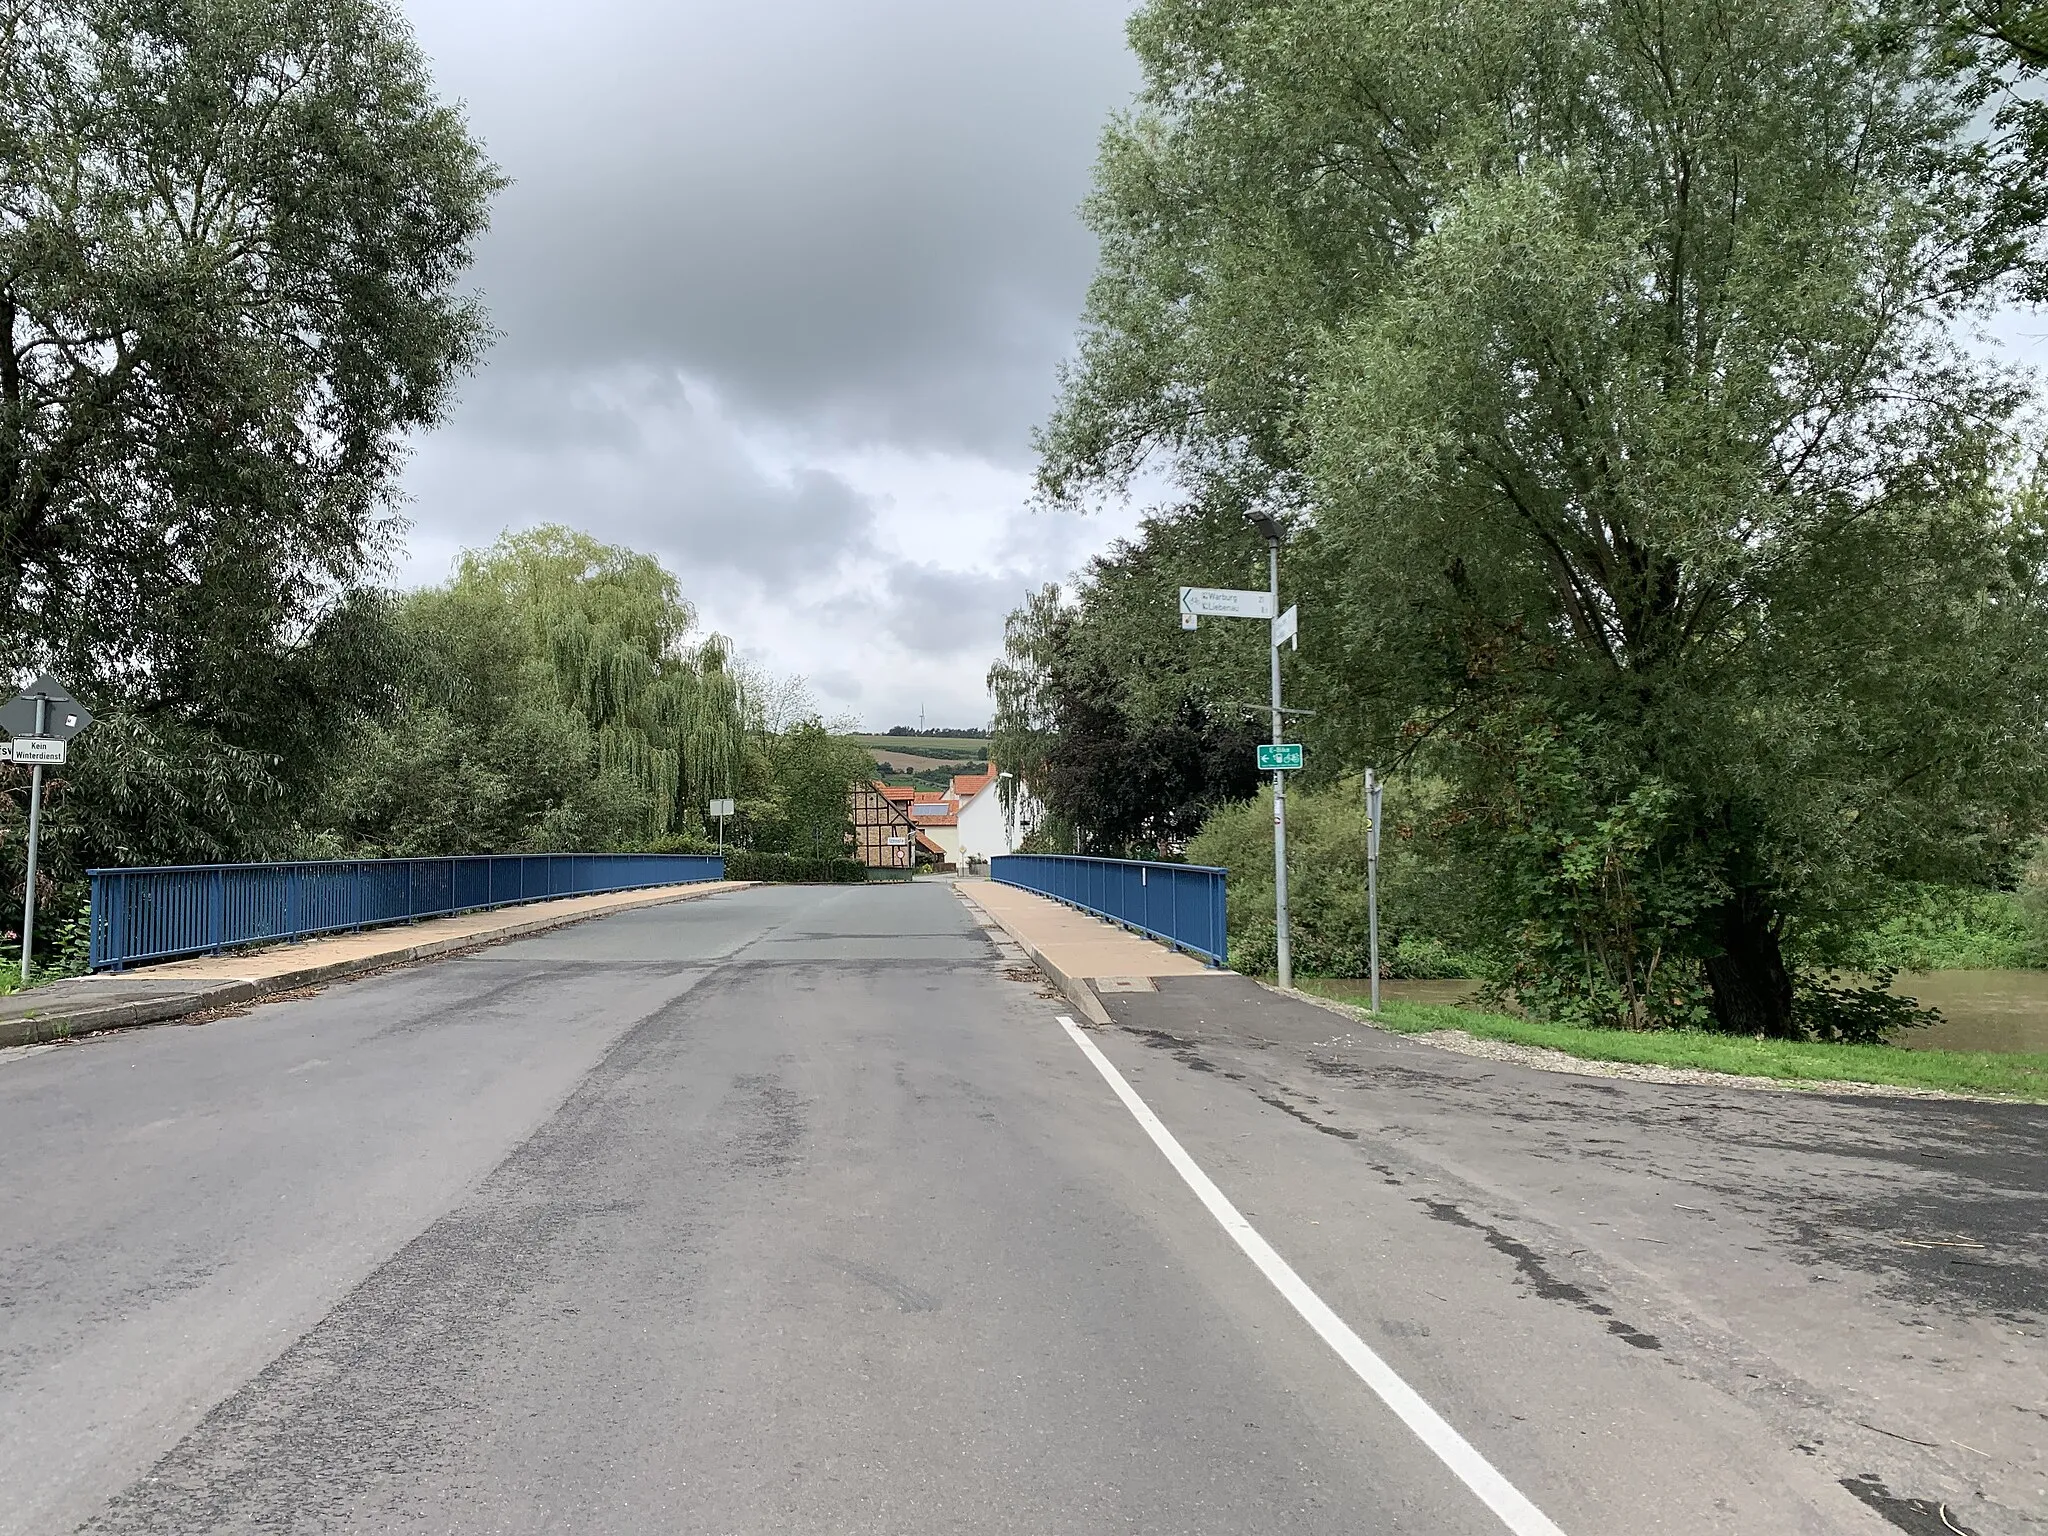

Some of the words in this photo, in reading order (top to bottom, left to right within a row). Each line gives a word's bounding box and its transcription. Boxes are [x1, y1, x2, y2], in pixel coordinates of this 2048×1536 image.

[1209, 592, 1237, 603] Warburg
[31, 742, 47, 750] Kein
[16, 751, 61, 760] Winterdienst
